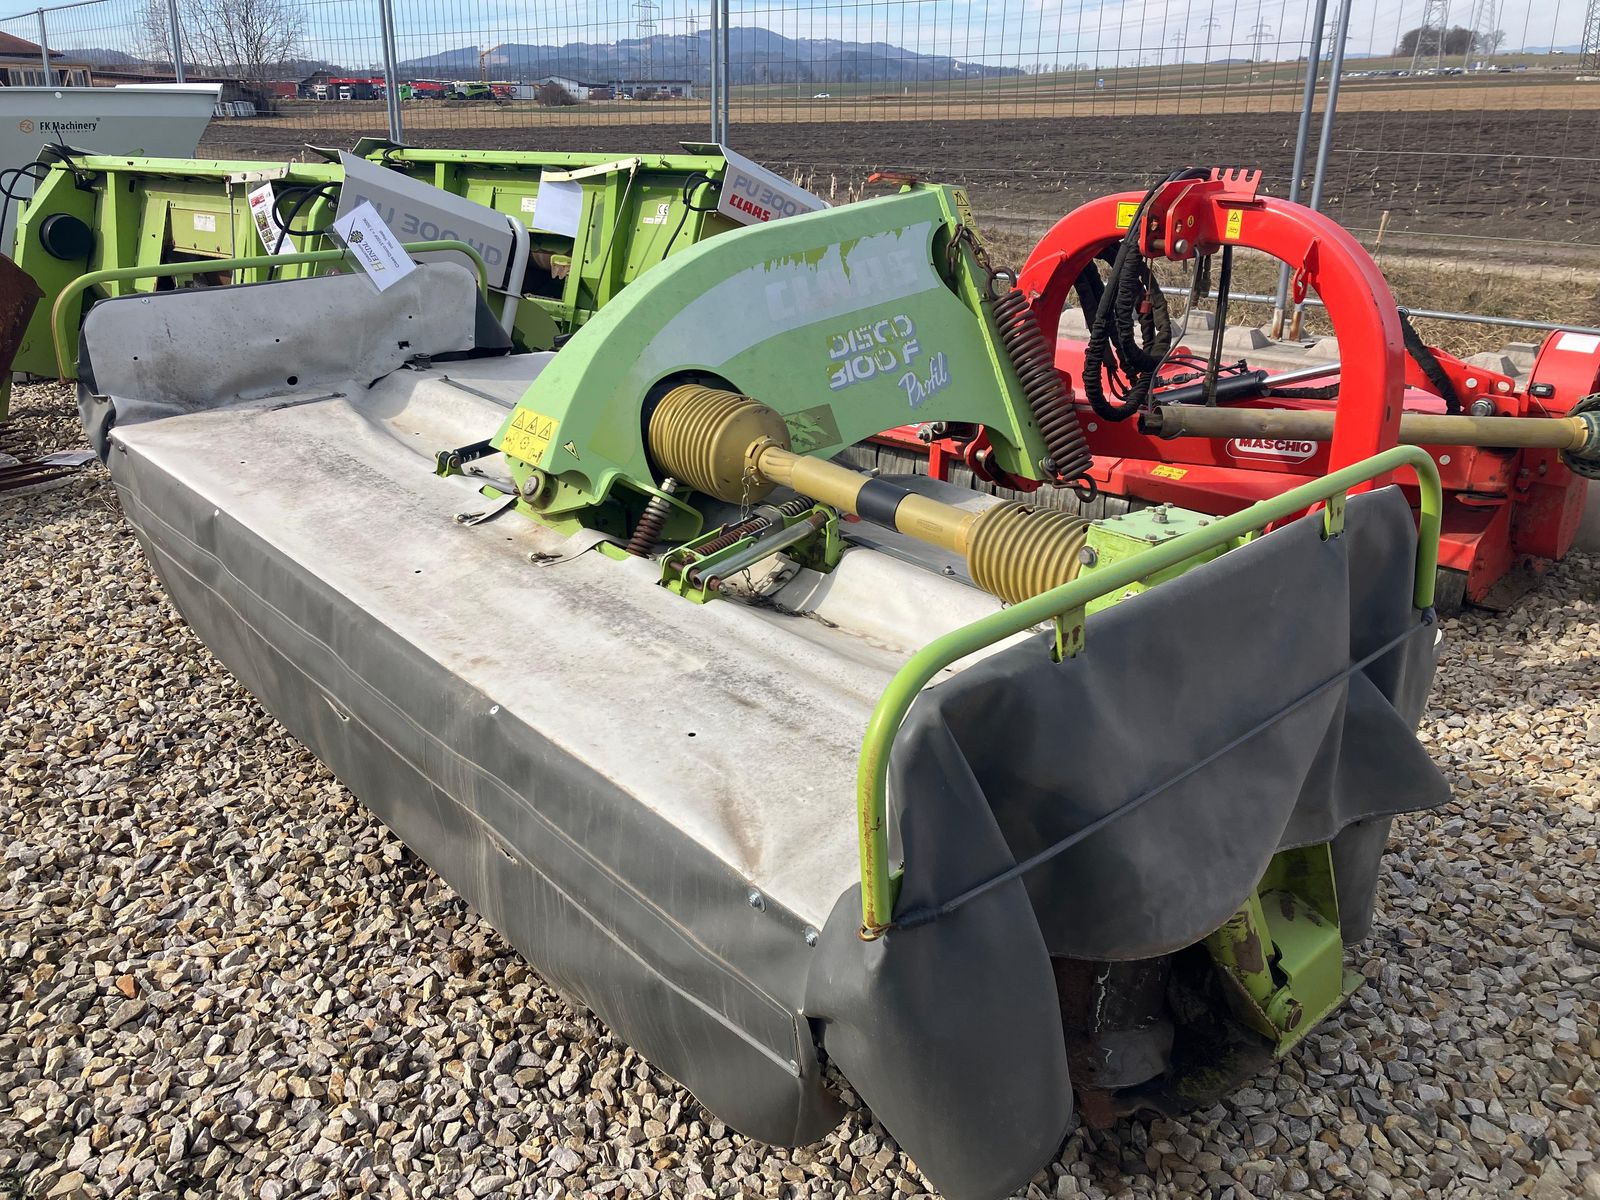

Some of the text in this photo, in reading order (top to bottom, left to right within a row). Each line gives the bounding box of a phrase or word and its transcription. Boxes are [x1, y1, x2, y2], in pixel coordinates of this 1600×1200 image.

[40, 121, 51, 131] FK
[53, 121, 97, 131] Machinery
[729, 193, 771, 223] CLAAS
[733, 174, 797, 216] PU 300
[360, 241, 385, 274] HEINDL
[827, 314, 917, 360] DISCO
[901, 338, 923, 366] F
[898, 350, 950, 411] Profil
[1239, 438, 1312, 453] MASCHIO
